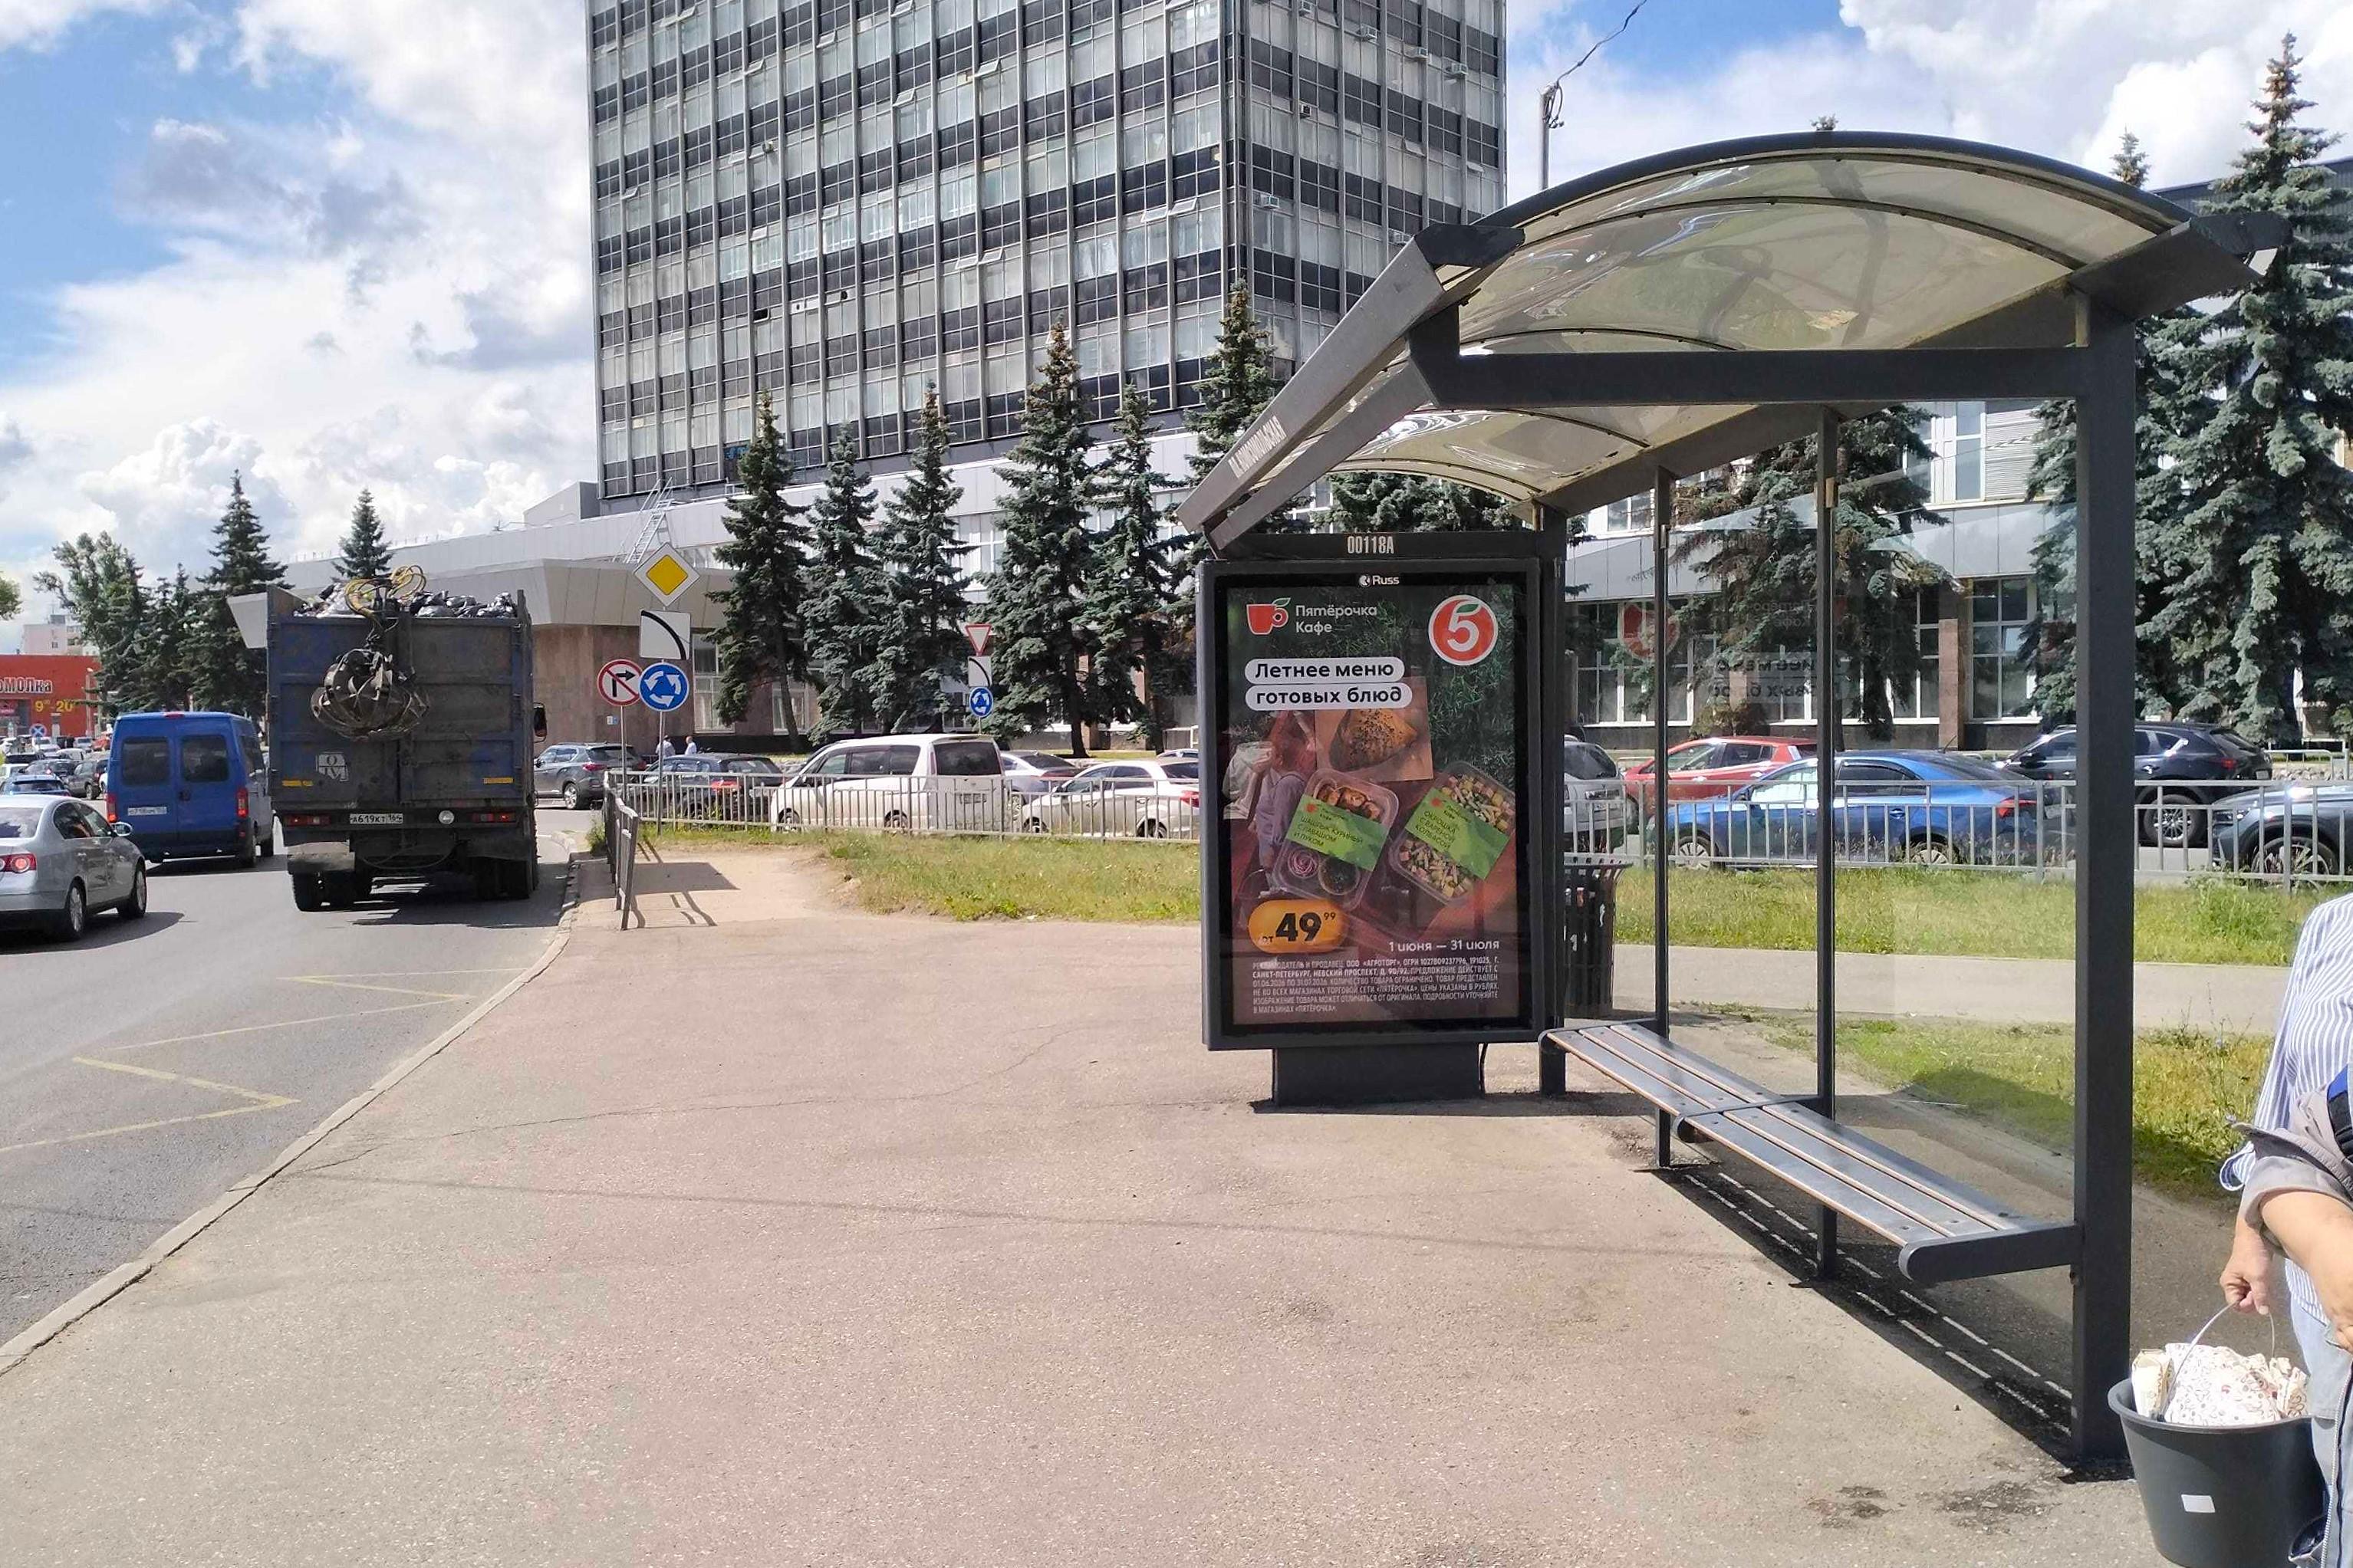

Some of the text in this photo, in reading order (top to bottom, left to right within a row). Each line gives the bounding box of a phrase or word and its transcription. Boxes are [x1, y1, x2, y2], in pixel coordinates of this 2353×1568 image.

[1347, 535, 1394, 554] 00118A
[1372, 575, 1400, 585] Russ
[1295, 604, 1377, 619] Пятёрочка
[1295, 621, 1333, 636] Кафе
[1255, 662, 1394, 679] Летнее меню
[1256, 686, 1402, 704] готовых блюд
[1275, 912, 1322, 942] 49
[1323, 912, 1336, 921] 99
[1389, 942, 1394, 952] 1
[1397, 942, 1432, 952] июня
[1450, 939, 1463, 950] 31
[1466, 940, 1500, 950] июля
